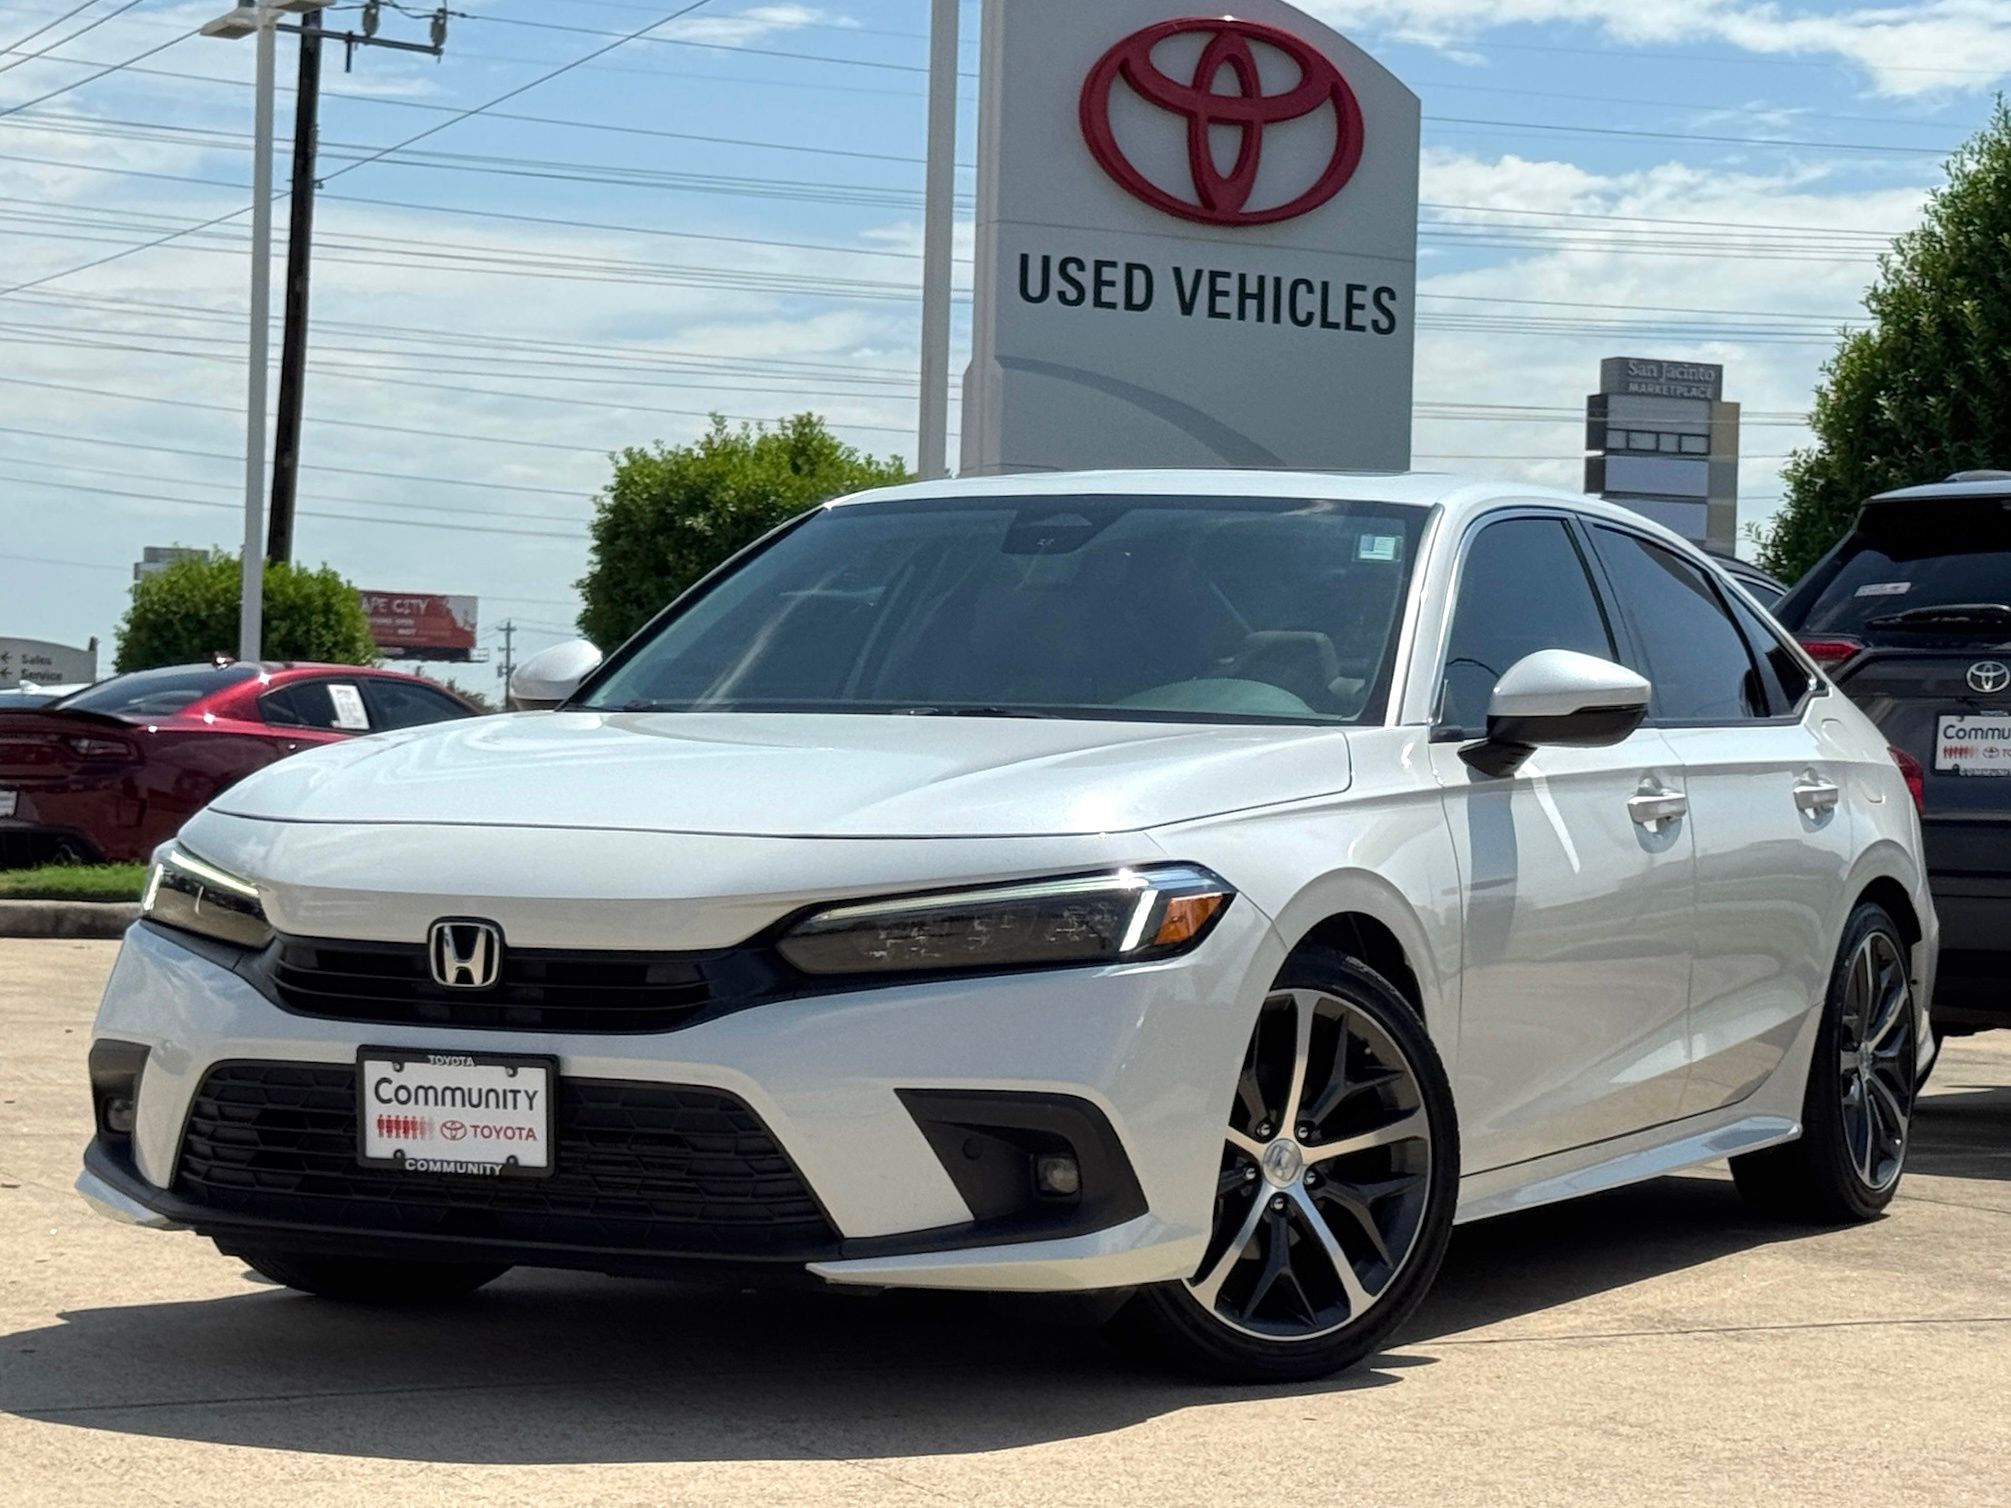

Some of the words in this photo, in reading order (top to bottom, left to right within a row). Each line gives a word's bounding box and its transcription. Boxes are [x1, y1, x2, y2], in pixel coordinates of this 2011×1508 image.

[1018, 253, 1154, 312] USED
[1172, 266, 1398, 336] VEHICLES
[1628, 360, 1658, 377] San
[1661, 362, 1716, 382] Jacinto
[1628, 383, 1713, 398] MARKETPLACE
[391, 598, 429, 615] CITY
[21, 653, 52, 666] Sales
[21, 667, 63, 681] Service
[427, 1055, 476, 1067] TOYOTA
[470, 1125, 537, 1141] TOYOTA
[405, 1159, 503, 1175] COMMUNITY
